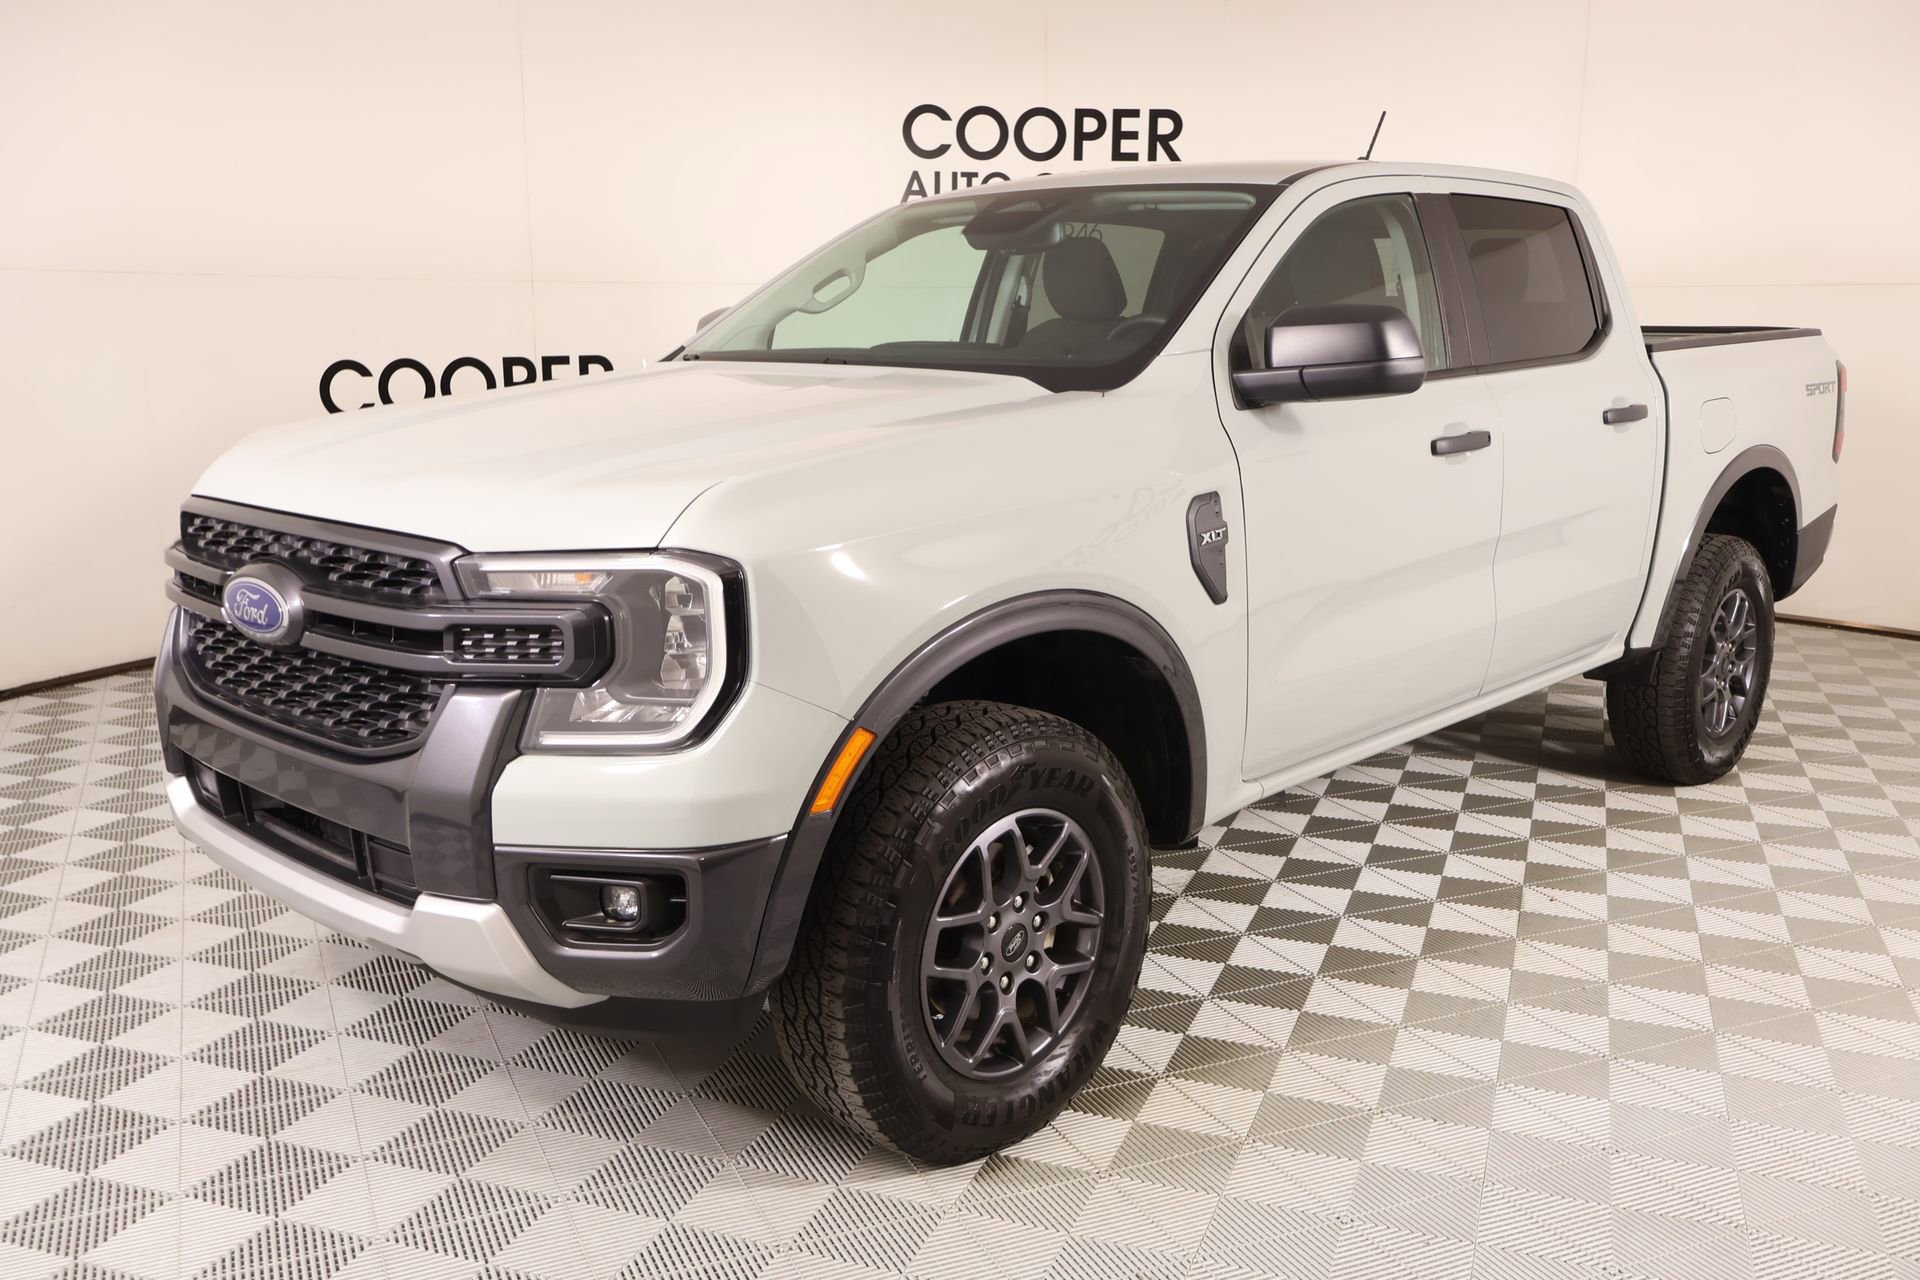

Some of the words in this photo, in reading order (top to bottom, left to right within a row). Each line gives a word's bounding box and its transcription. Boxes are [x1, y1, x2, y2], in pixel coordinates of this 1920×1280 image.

[902, 103, 1184, 162] COOPER
[1805, 381, 1836, 397] SPORT
[1200, 527, 1226, 546] XLT
[234, 588, 268, 626] Ford
